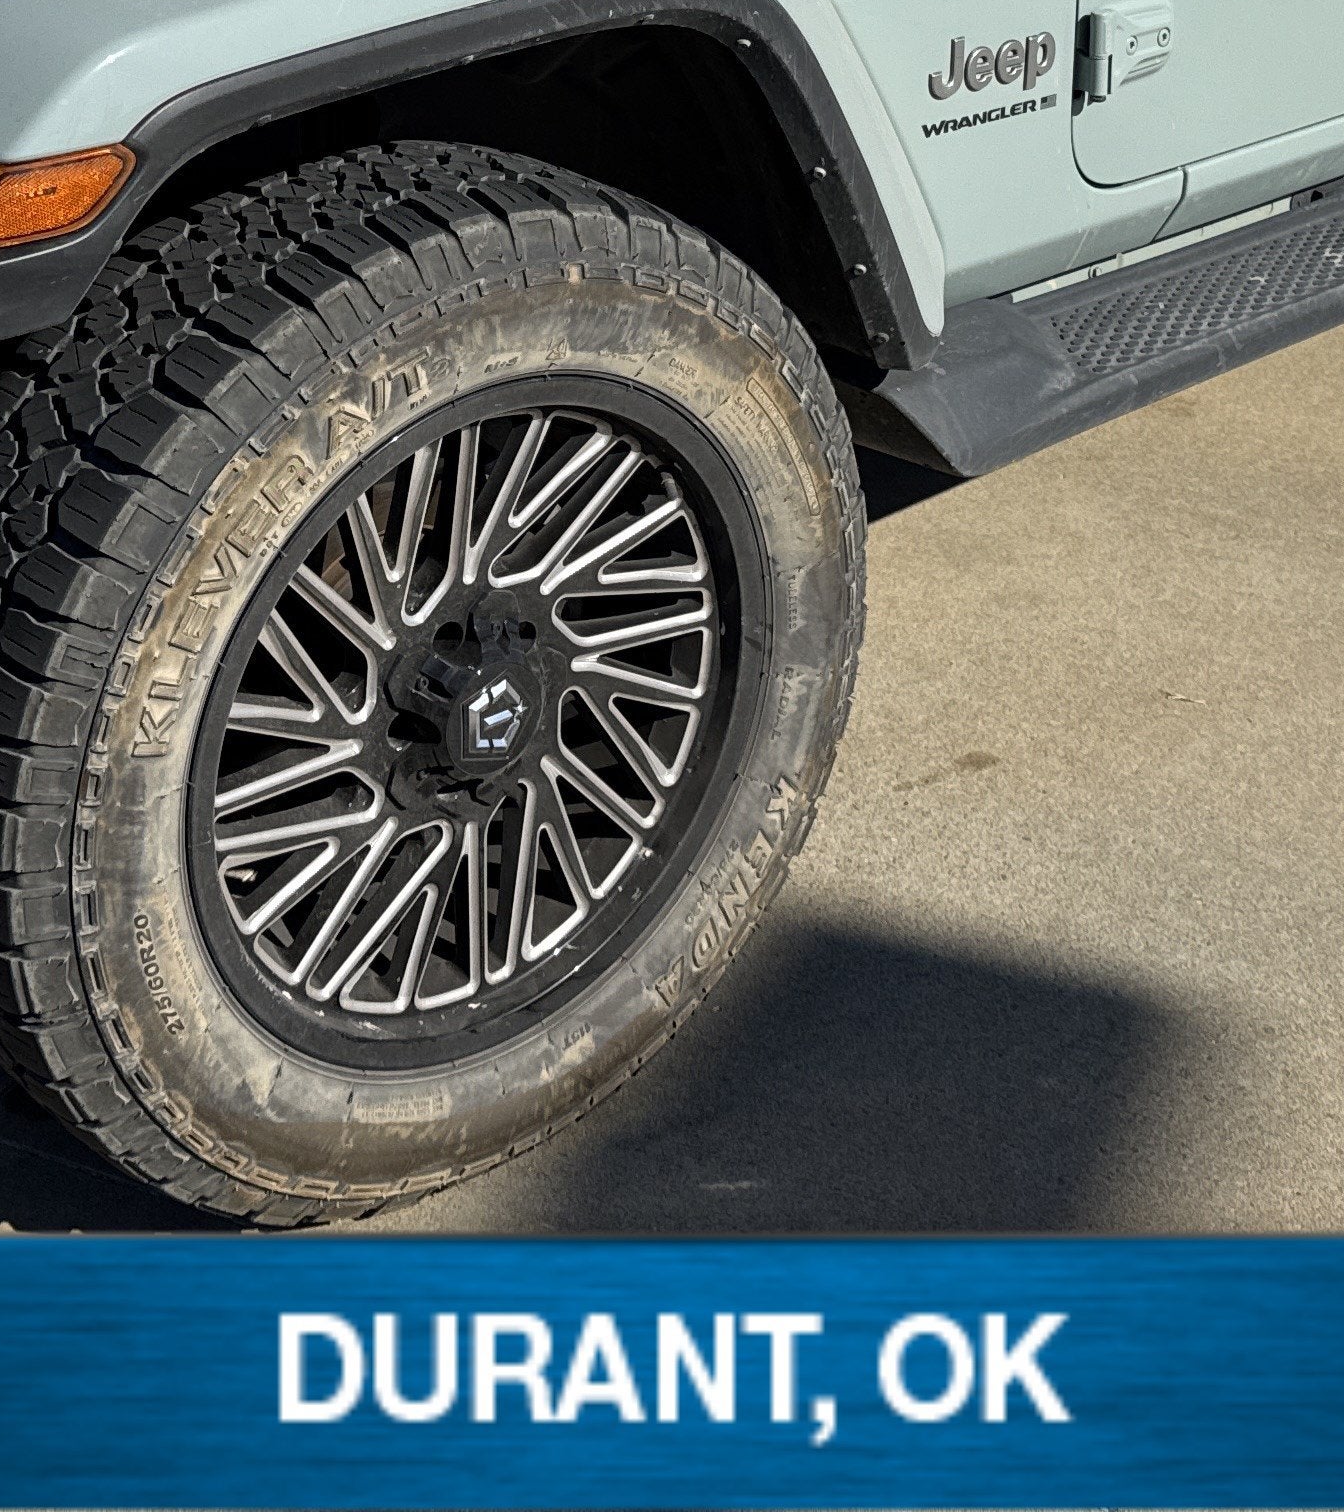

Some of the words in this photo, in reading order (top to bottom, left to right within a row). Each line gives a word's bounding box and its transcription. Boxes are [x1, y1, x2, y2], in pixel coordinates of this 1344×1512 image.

[920, 98, 1038, 139] WRANGLER
[928, 31, 1056, 100] Jeep
[130, 453, 316, 758] KLEVER
[656, 773, 798, 1008] KENDA
[133, 914, 185, 1035] 275/60R20
